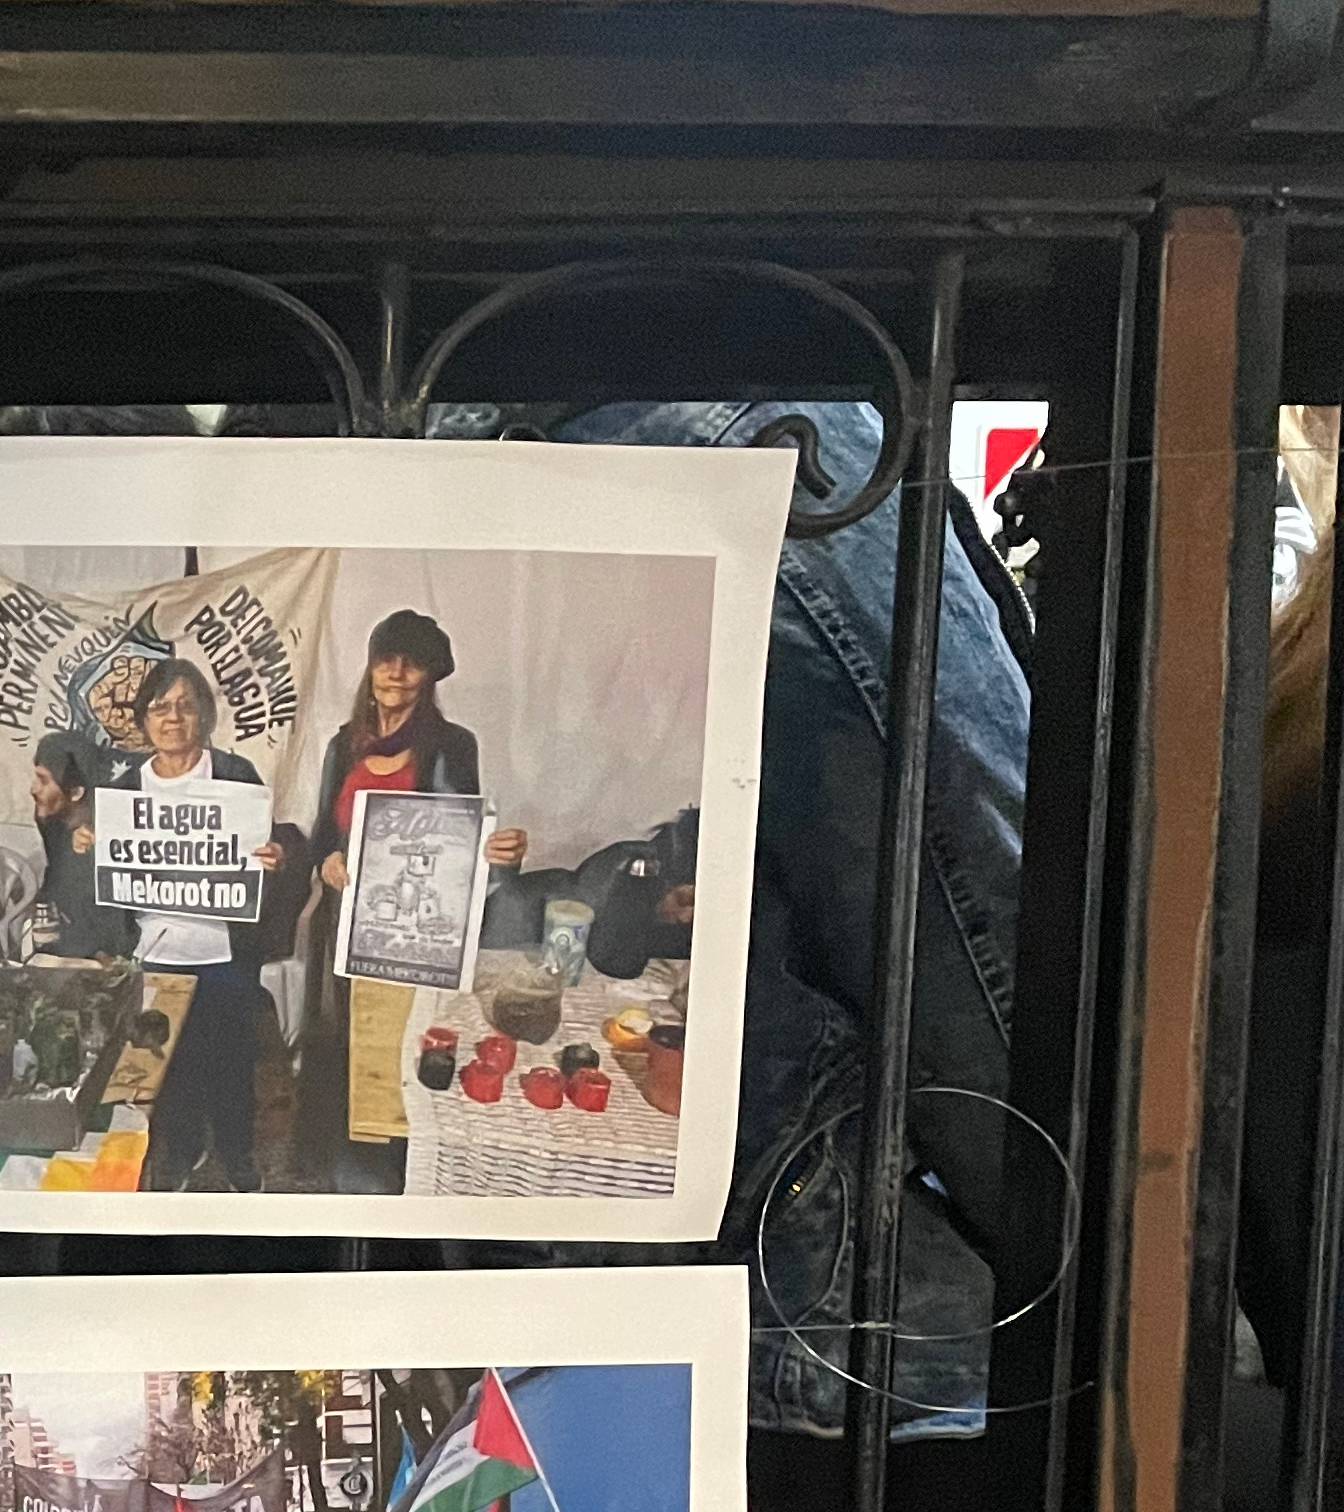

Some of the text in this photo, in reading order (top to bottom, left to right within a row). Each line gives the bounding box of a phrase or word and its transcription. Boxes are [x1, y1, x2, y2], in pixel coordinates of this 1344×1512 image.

[184, 604, 267, 742] POR EL AGUA
[133, 796, 223, 836] El agua
[109, 833, 249, 871] es esencial,
[112, 871, 248, 909] Mekorot no
